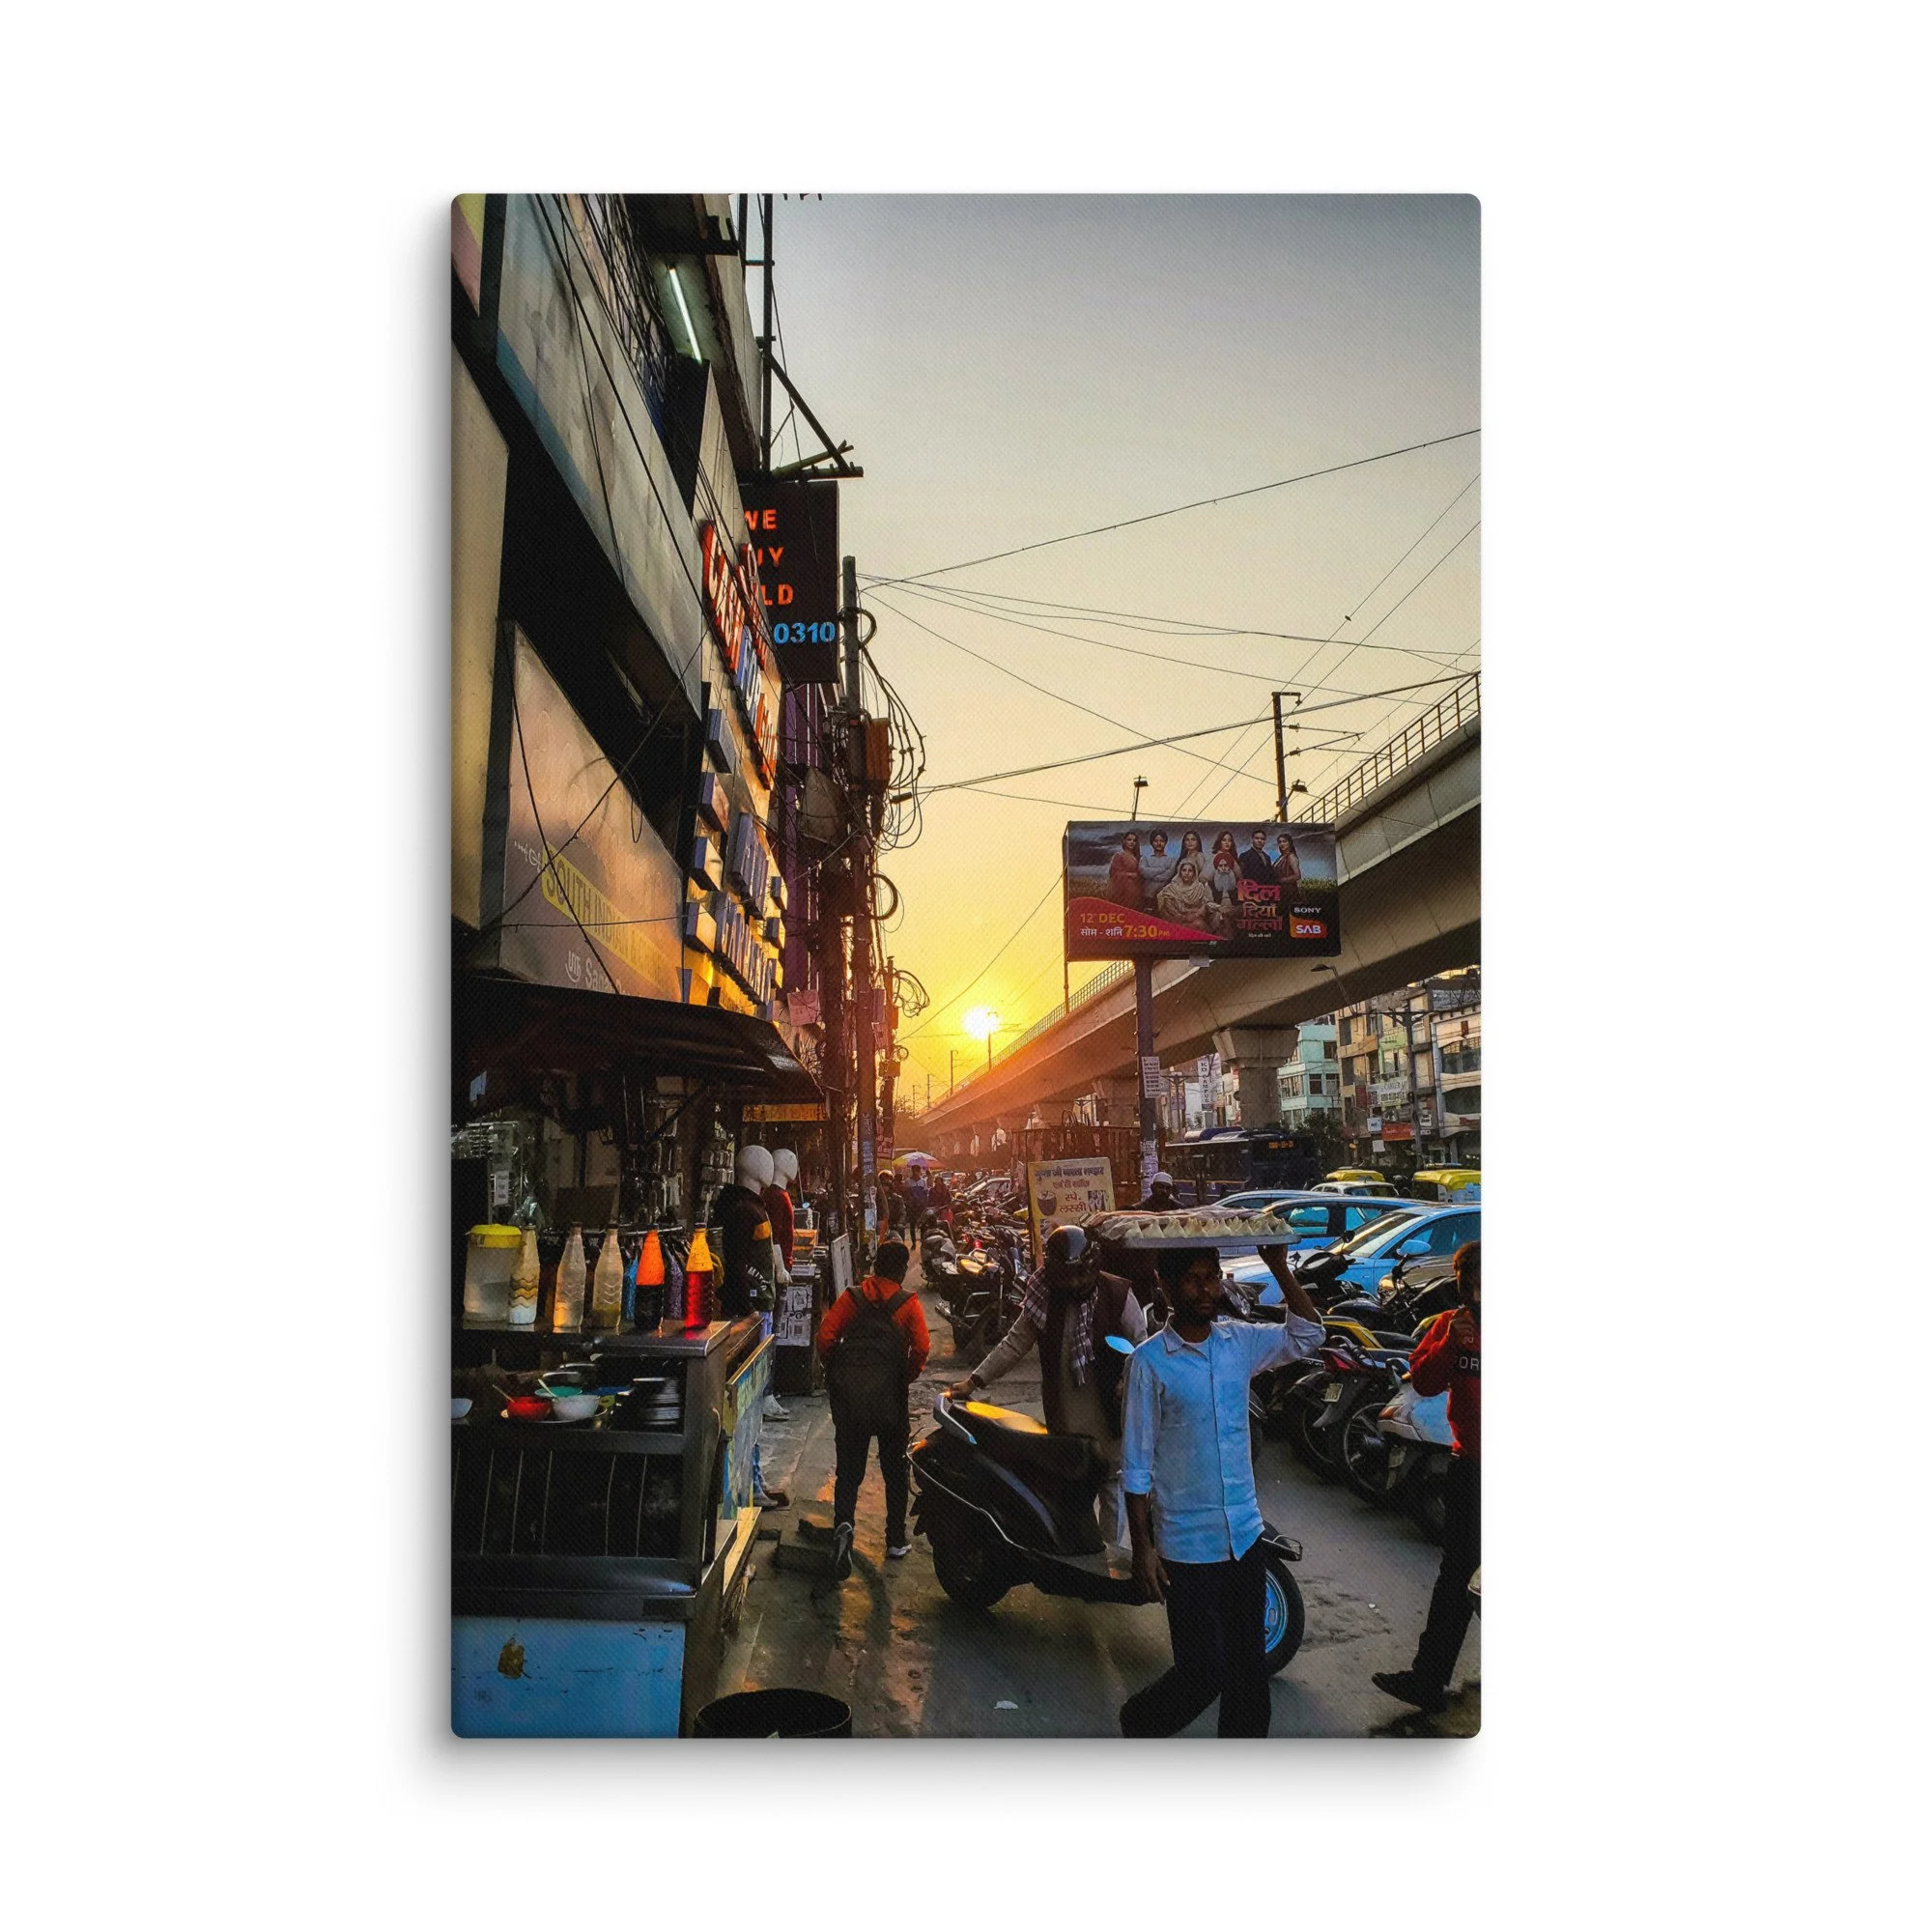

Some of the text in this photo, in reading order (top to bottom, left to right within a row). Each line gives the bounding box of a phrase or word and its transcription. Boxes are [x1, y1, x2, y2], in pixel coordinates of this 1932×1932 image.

[774, 621, 836, 644] 0310
[545, 850, 591, 921] SOUTH
[1236, 879, 1281, 902] दिल
[1080, 913, 1125, 923] 12 DEC
[1080, 925, 1098, 938] सोम
[1105, 925, 1122, 938] शनि
[1295, 924, 1321, 934] SAB
[1059, 1202, 1087, 1213] लस्सी
[1459, 1356, 1479, 1370] OR
